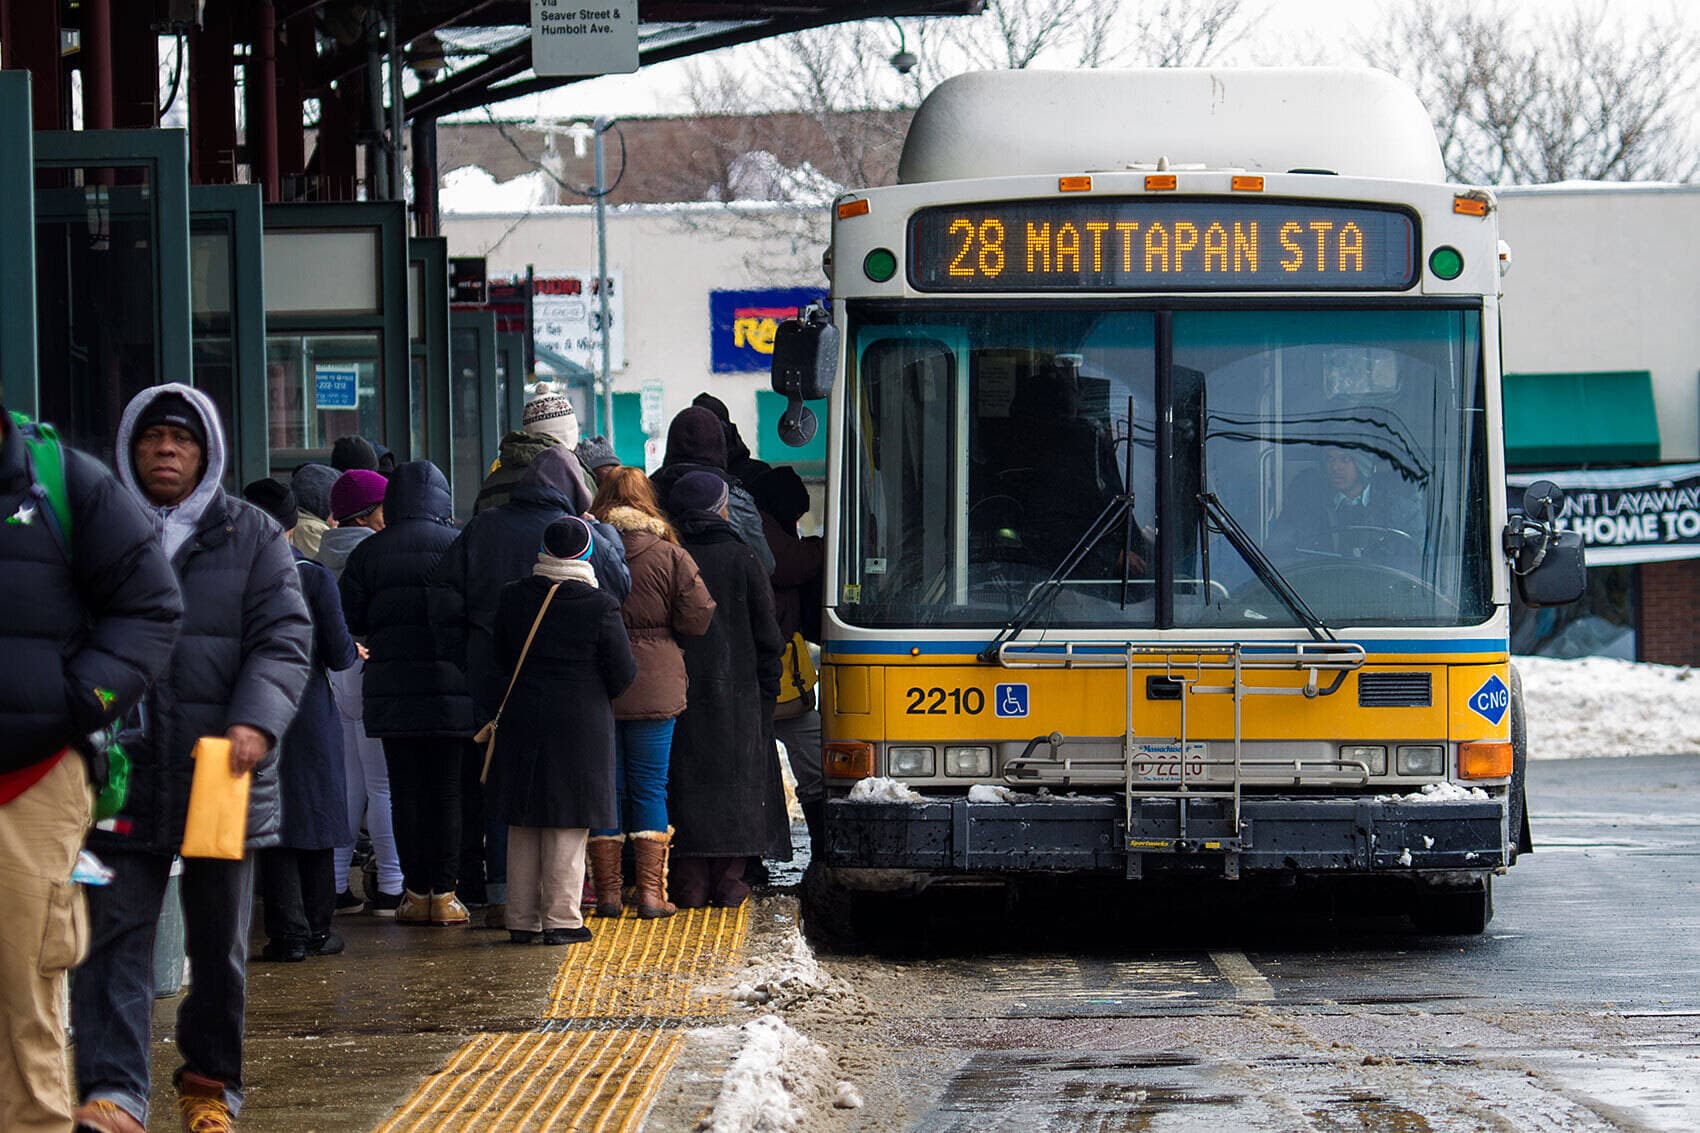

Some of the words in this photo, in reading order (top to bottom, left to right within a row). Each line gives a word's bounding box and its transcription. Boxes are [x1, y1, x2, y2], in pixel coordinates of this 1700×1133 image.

[541, 10, 576, 21] Seaver
[579, 9, 610, 19] Street
[613, 8, 620, 19] &
[541, 24, 587, 34] Humbolt
[590, 23, 613, 33] Ave.
[949, 219, 1005, 276] 28
[1027, 221, 1257, 272] MATTAPAN
[1280, 221, 1363, 272] STA
[1603, 487, 1700, 516] LAYAWAY
[1572, 513, 1658, 545] HOME
[906, 687, 985, 715] 2210
[1477, 689, 1507, 711] CNG
